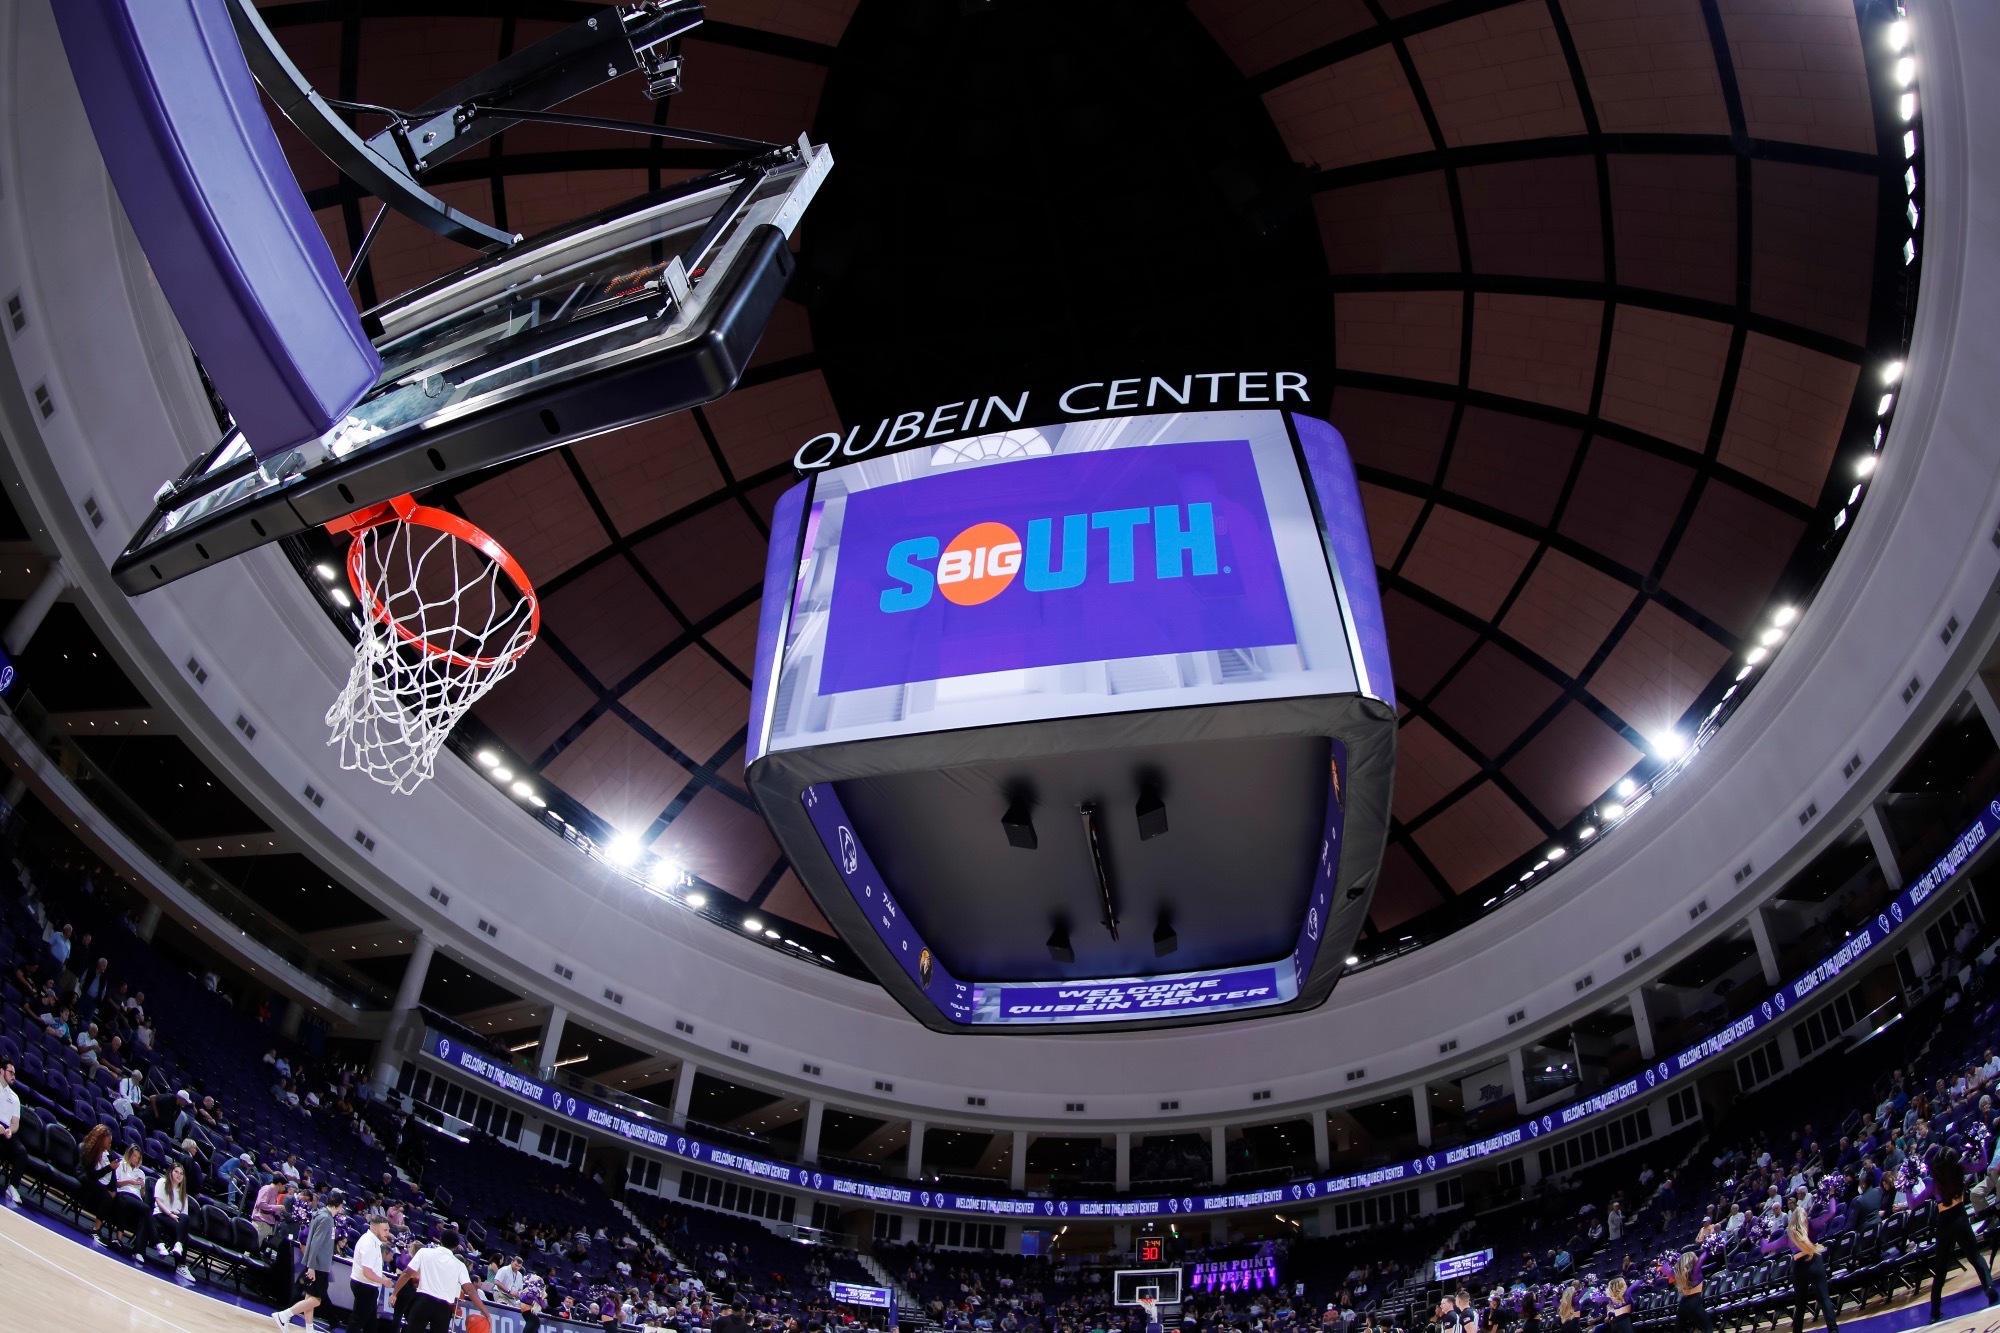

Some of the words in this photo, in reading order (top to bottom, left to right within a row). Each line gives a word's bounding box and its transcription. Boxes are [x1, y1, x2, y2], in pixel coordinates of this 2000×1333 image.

[794, 391, 1029, 469] QUBEIN
[1058, 371, 1311, 414] CENTER
[937, 541, 1022, 584] BIG
[1910, 873, 1935, 905] WELCOME
[1931, 867, 1941, 885] TO
[1964, 821, 1986, 852] CENTER
[1794, 971, 1819, 998] WELCOME
[1817, 966, 1825, 981] TO
[1851, 930, 1872, 956] CENTER
[1008, 1001, 1133, 1014] QUBEIN
[1139, 987, 1270, 1007] CENTER
[1059, 979, 1221, 998] WELCOME
[1083, 994, 1127, 1004] TO
[1132, 988, 1196, 1001] THE
[1678, 1046, 1702, 1069] WELCOME
[1701, 1042, 1708, 1056] TO
[1735, 1015, 1755, 1037] CENTER
[461, 1052, 486, 1076] WELCOME
[486, 1065, 494, 1078] TO
[522, 1082, 543, 1100] CENTER
[1562, 1105, 1585, 1123] WELCOME
[1585, 1101, 1592, 1114] TO
[1619, 1080, 1638, 1099] CENTER
[587, 1108, 613, 1128] WELCOME
[612, 1116, 620, 1130] TO
[648, 1130, 668, 1146] CENTER
[1446, 1148, 1469, 1164] WELCOME
[1469, 1145, 1475, 1157] TO
[1504, 1129, 1521, 1146] CENTER
[711, 1150, 736, 1166] WELCOME
[736, 1156, 742, 1168] TO
[771, 1165, 790, 1180] CENTER
[833, 1180, 857, 1194] WELCOME
[857, 1184, 864, 1195] TO
[892, 1190, 911, 1202] CENTER
[1327, 1178, 1350, 1192] WELCOME
[1350, 1177, 1357, 1187] TO
[1385, 1166, 1403, 1180] CENTER
[956, 1198, 979, 1210] WELCOME
[980, 1200, 986, 1210] TO
[1015, 1203, 1034, 1213] CENTER
[1080, 1204, 1103, 1214] WELCOME
[1104, 1204, 1110, 1214] TO
[1140, 1202, 1158, 1213] CENTER
[1204, 1197, 1227, 1209] WELCOME
[1228, 1196, 1234, 1206] TO
[1264, 1190, 1282, 1202] CENTER
[1143, 1247, 1157, 1260] 30
[1196, 1261, 1227, 1273] HIGH
[1232, 1256, 1273, 1270] POINT
[1193, 1267, 1276, 1285] UNIVERSITY
